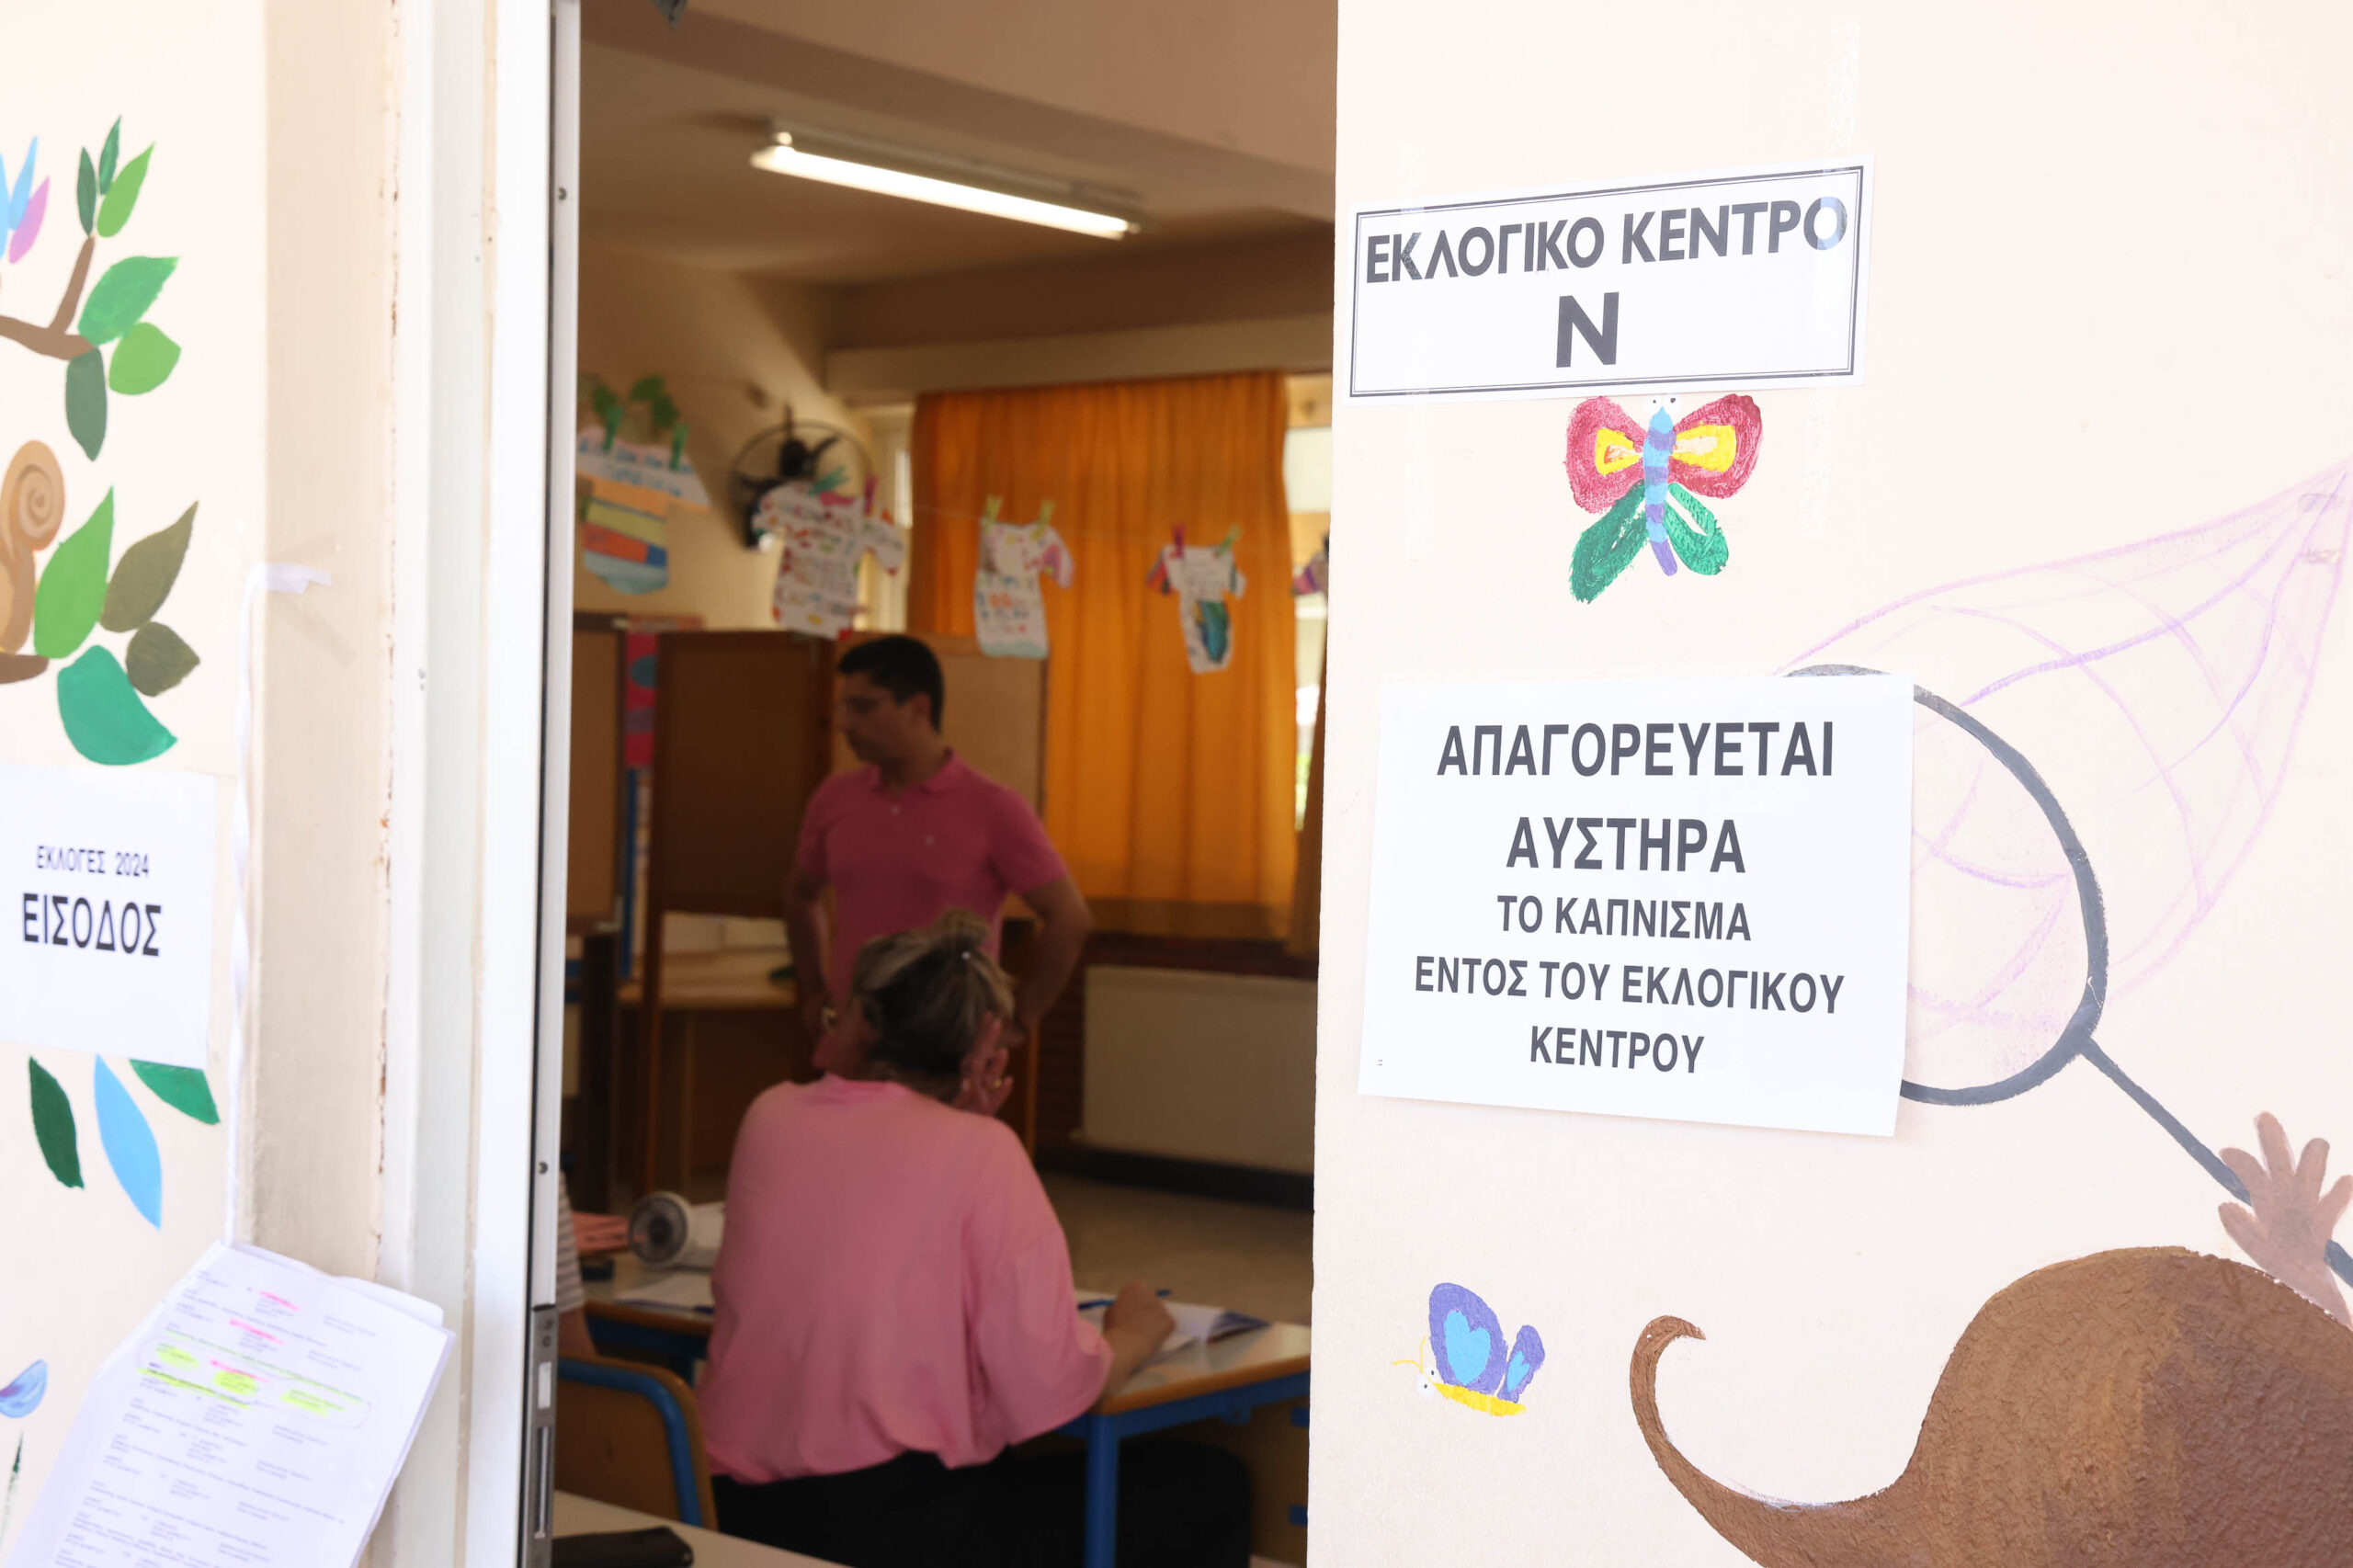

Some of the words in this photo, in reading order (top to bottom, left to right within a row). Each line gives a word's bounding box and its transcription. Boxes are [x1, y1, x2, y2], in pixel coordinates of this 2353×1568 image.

[1367, 217, 1605, 283] ΕΚΛΟΓΙΚΟ
[1622, 196, 1848, 265] ΚΕΝΤΡΟ
[1556, 292, 1620, 368] Ν
[1437, 722, 1834, 777] ΑΠΑΓΟΡΕΥΕΤΑΙ
[37, 846, 106, 874] ΕΚΛΟΓΕΣ
[116, 852, 150, 877] 2024
[1506, 817, 1745, 873] ΑΥΣΤΗΡΑ
[22, 892, 162, 957] ΕΙΣΟΔΟΣ
[1497, 895, 1542, 933] ΤΟ
[1556, 897, 1751, 940] ΚΑΠΝΙΣΜΑ
[1415, 956, 1528, 997] ΕΝΤΟΣ
[1540, 961, 1610, 1000] ΤΟΥ
[1622, 965, 1845, 1014] ΕΚΛΟΓΙΚΟΥ
[1530, 1026, 1705, 1074] ΚΕΝΤΡΟΥ
